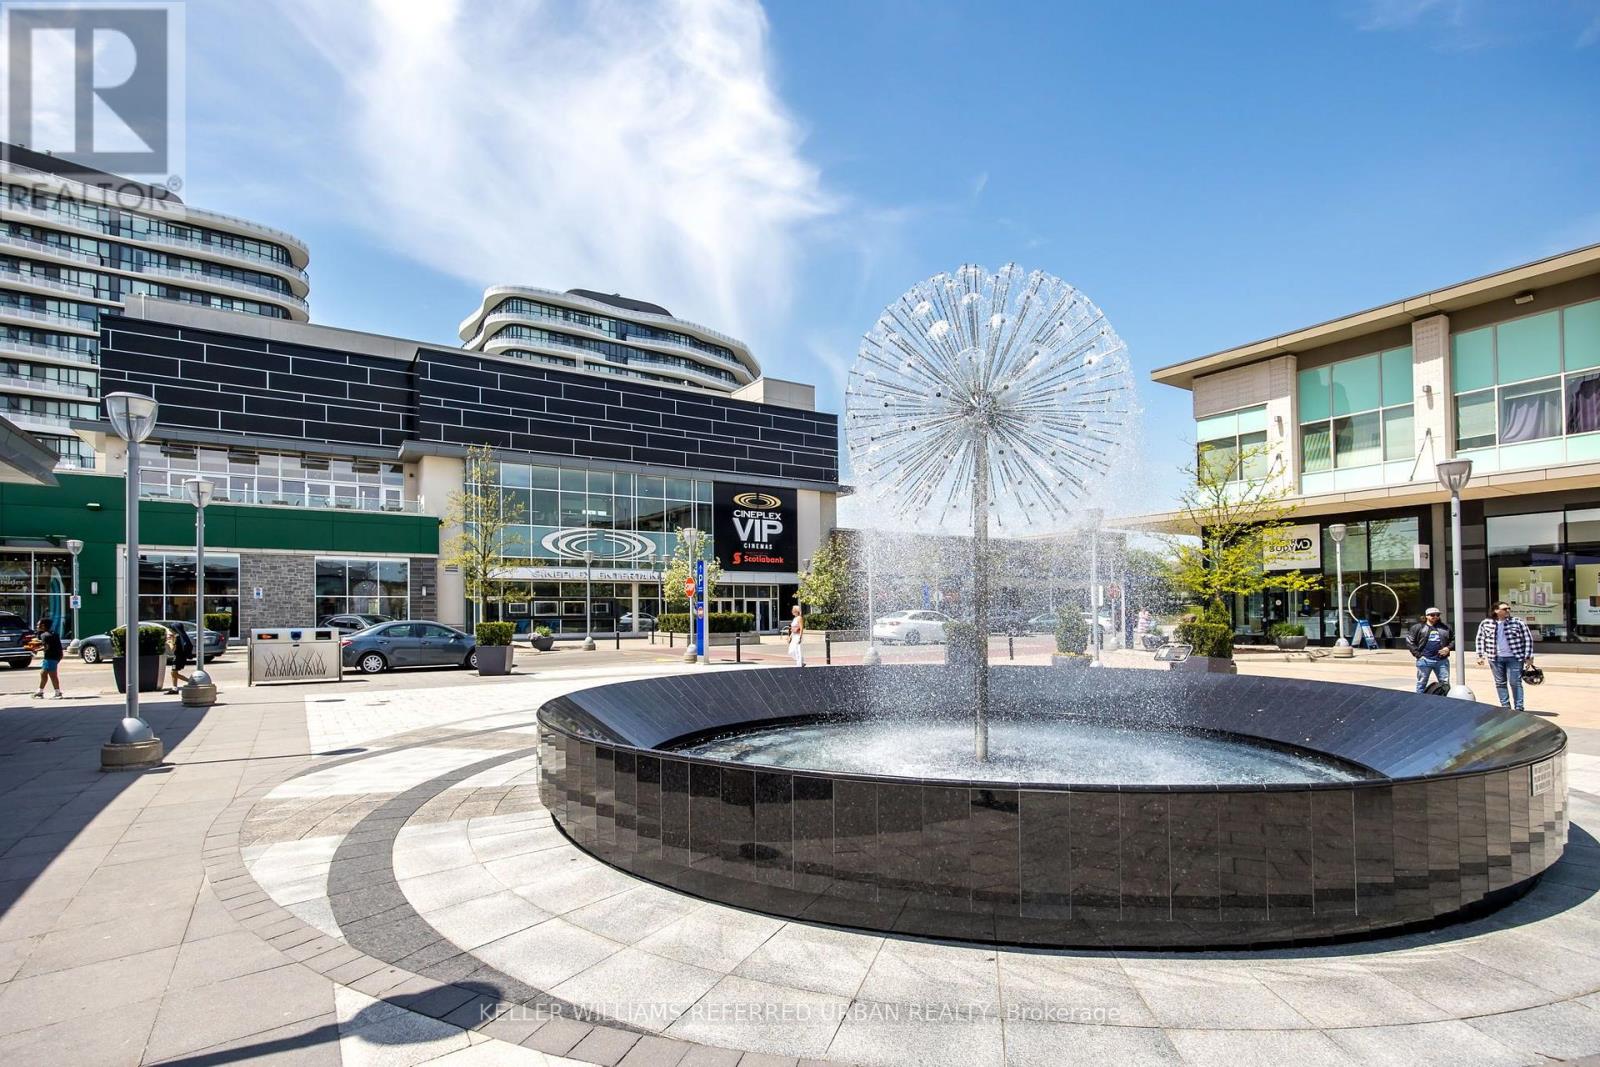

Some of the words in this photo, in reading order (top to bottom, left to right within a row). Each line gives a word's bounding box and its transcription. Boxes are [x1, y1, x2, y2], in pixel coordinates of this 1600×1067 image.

[733, 509, 782, 520] CINEPLEX
[732, 517, 783, 543] VIP
[743, 542, 773, 550] CINEMAS
[744, 555, 784, 564] Scotiabank
